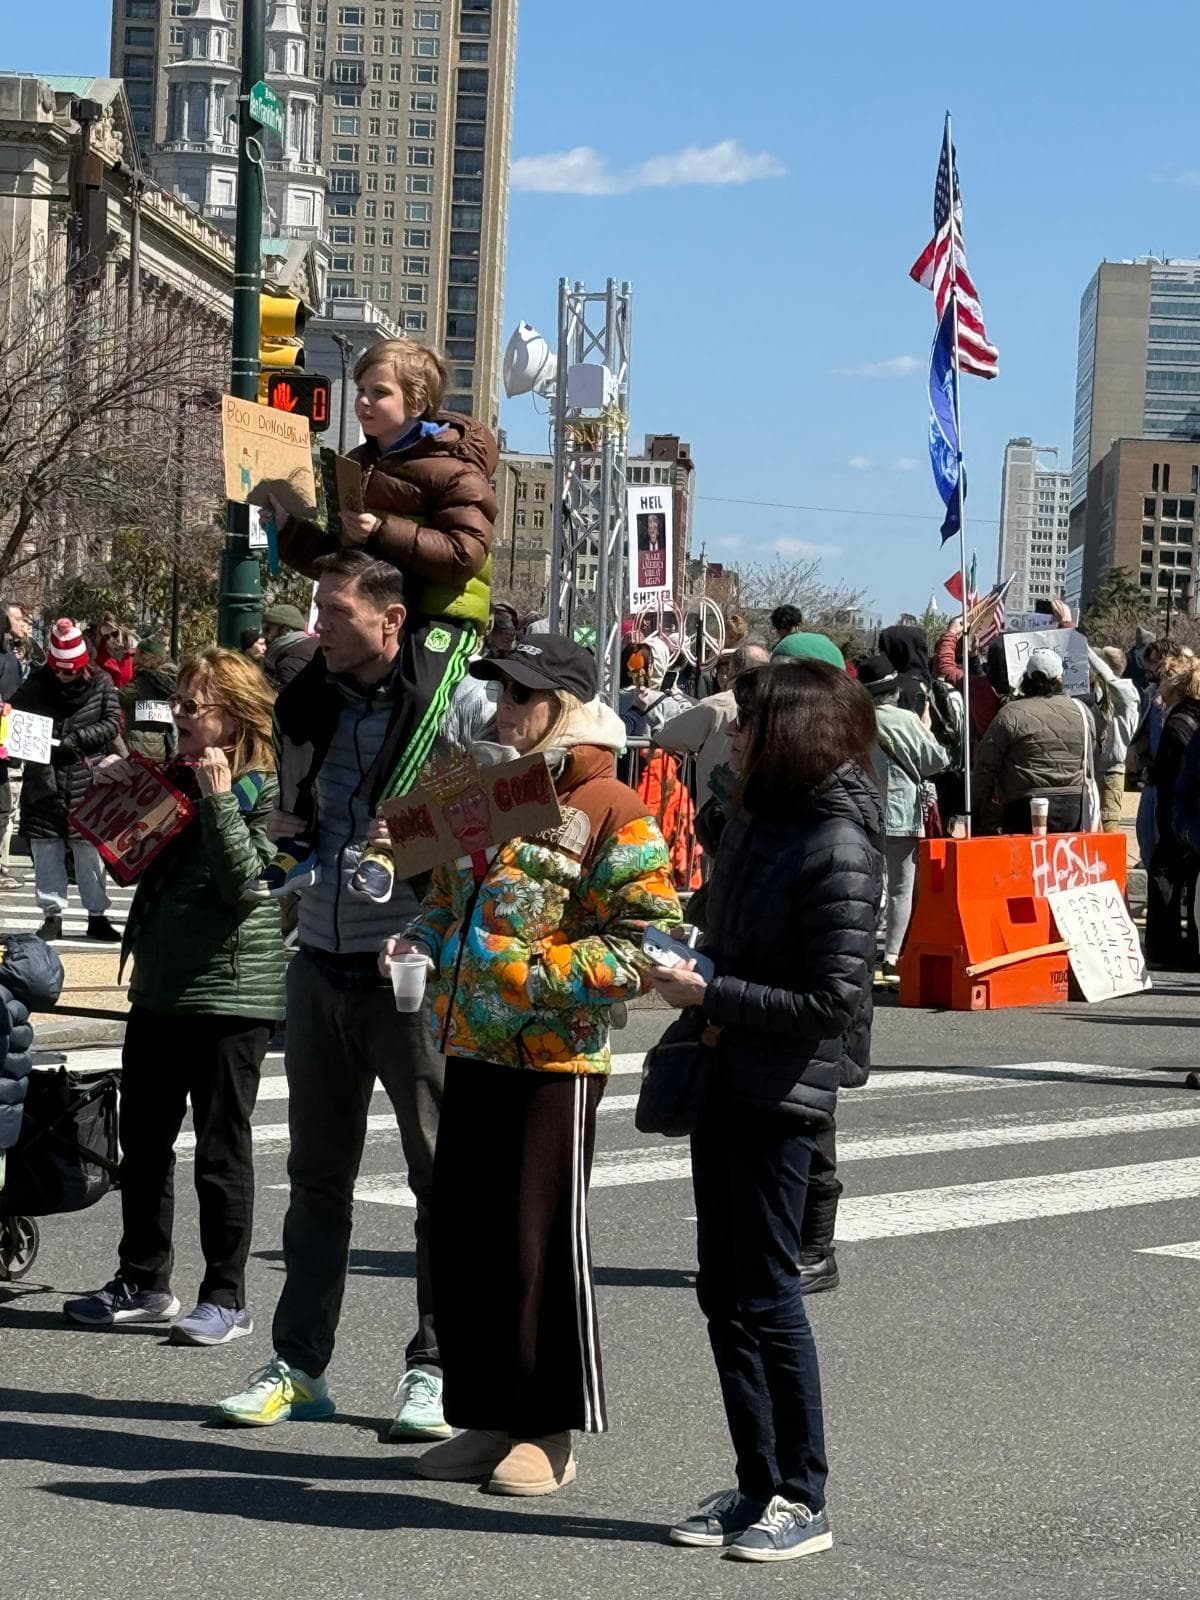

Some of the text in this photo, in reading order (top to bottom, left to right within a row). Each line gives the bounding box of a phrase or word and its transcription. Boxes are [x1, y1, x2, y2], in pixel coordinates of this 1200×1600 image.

[314, 387, 326, 421] 0
[640, 496, 663, 510] HEIL
[123, 768, 163, 807] NO
[81, 781, 164, 865] KINGS
